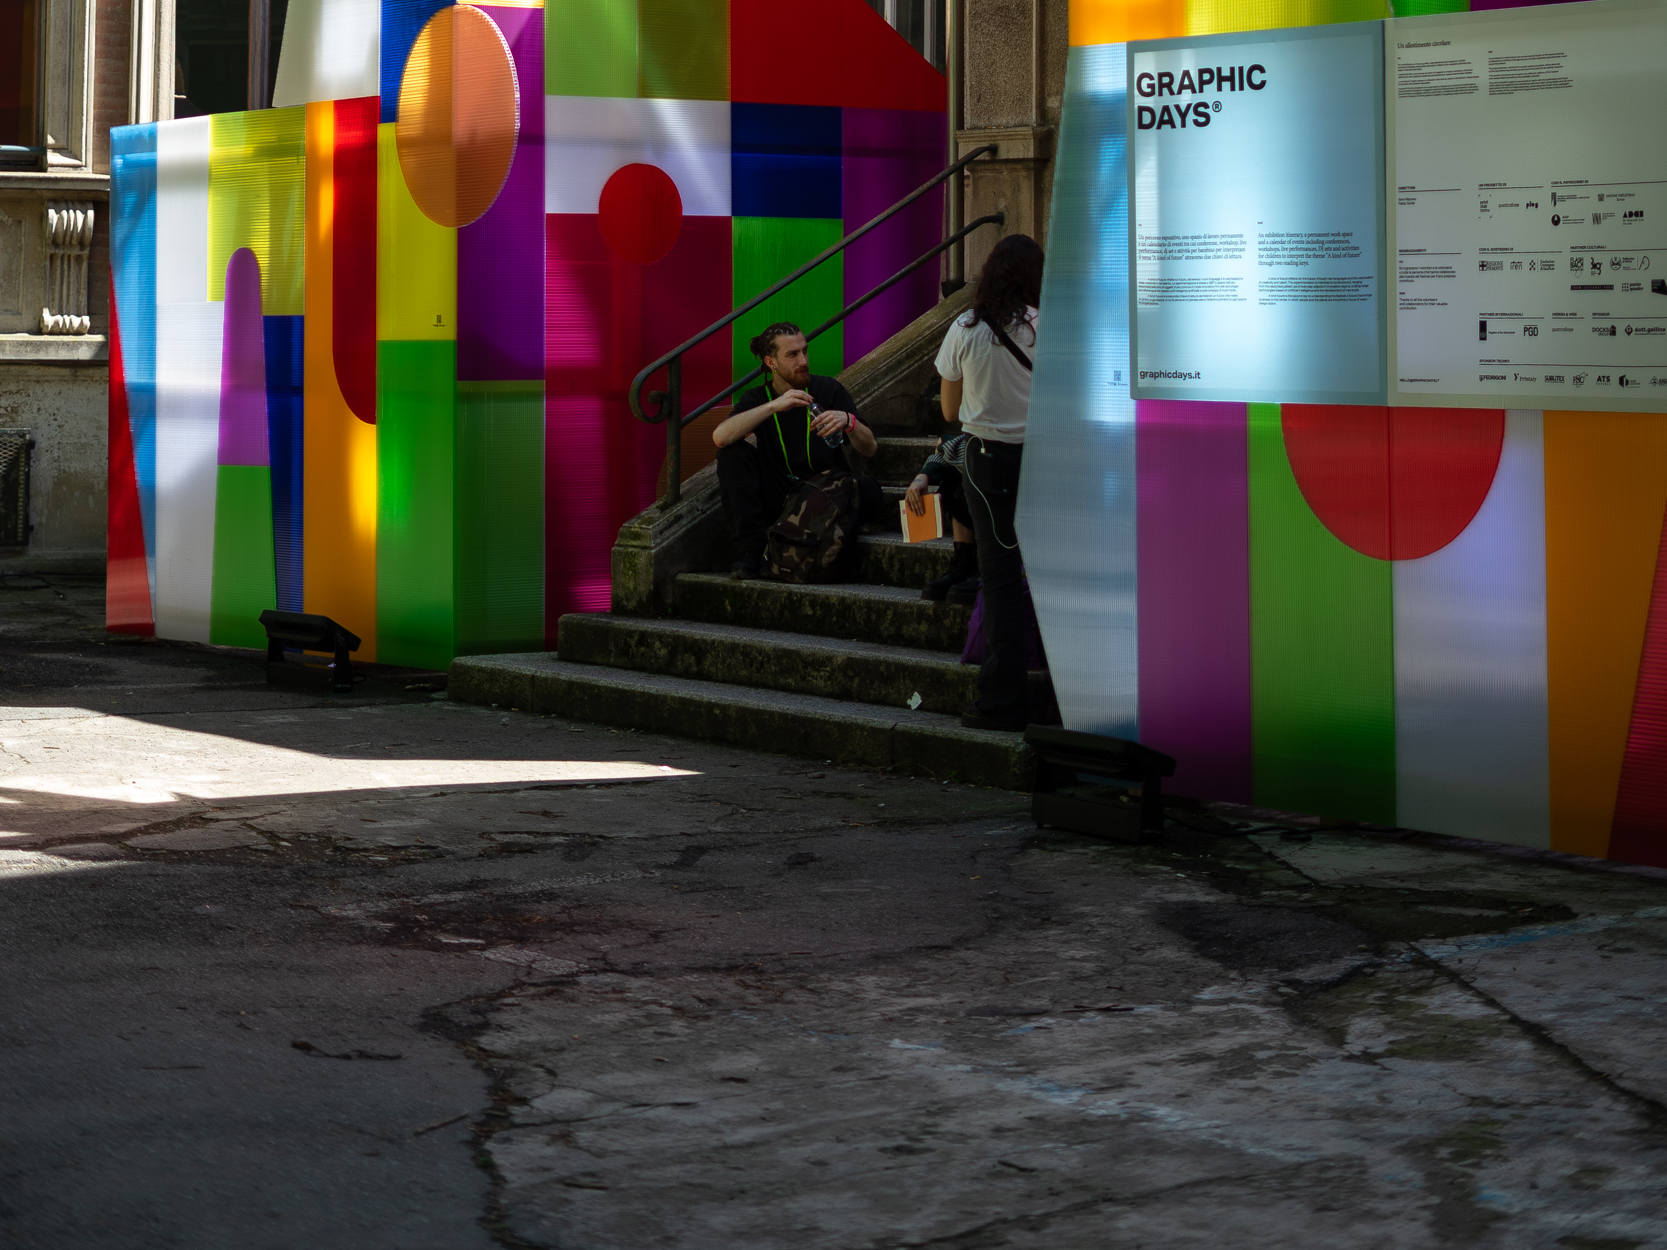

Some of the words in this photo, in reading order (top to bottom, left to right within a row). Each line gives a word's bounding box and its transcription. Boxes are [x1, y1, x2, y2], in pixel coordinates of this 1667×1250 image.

[1136, 64, 1266, 97] GRAPHIC
[1524, 327, 1538, 336] PGD
[1140, 370, 1201, 380] graphicdays.it
